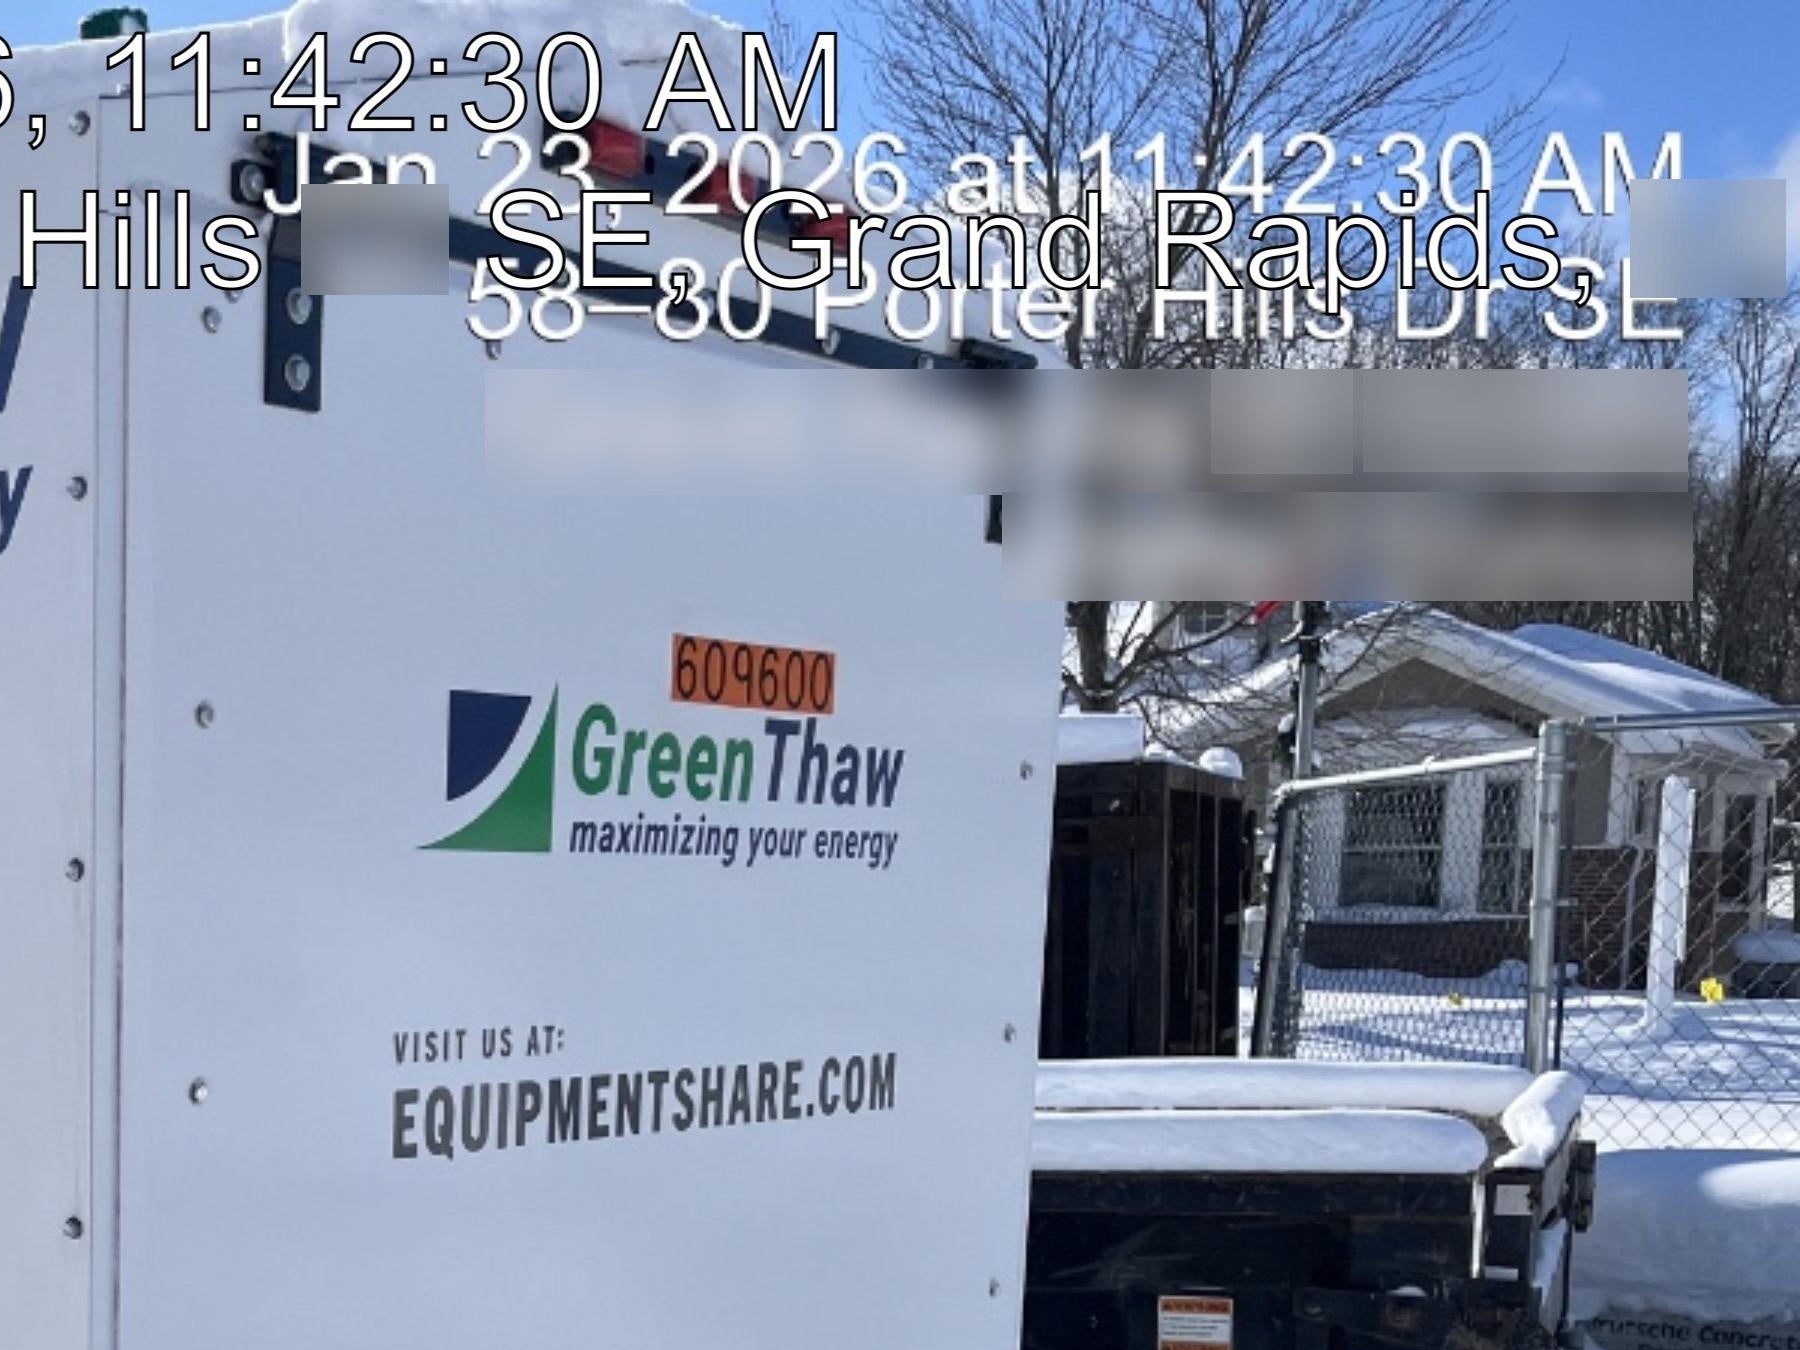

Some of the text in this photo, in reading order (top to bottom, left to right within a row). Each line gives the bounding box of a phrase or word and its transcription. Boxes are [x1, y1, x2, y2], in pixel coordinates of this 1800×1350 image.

[677, 636, 831, 711] 609600
[569, 810, 899, 870] maximizing your energy
[393, 1024, 565, 1064] VISIT US AT:
[392, 1052, 898, 1160] EQUIPMENTSHARE.COM
